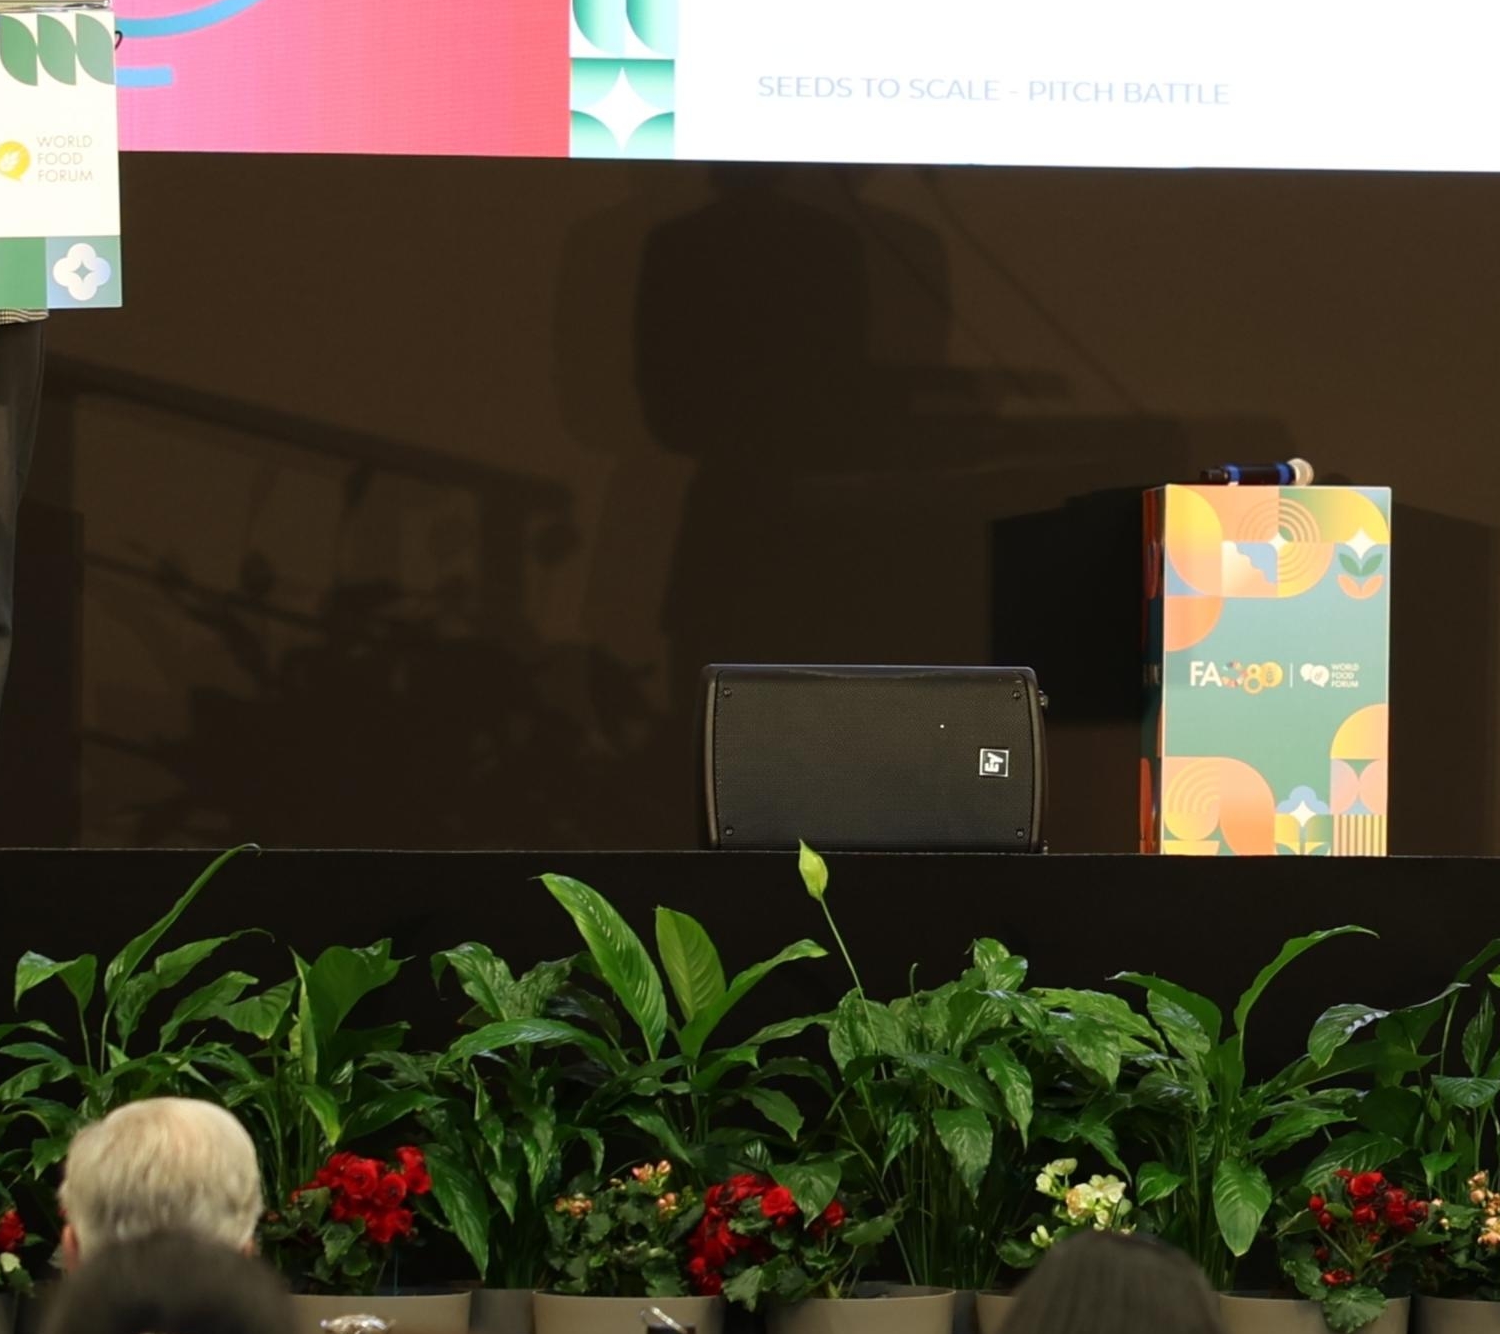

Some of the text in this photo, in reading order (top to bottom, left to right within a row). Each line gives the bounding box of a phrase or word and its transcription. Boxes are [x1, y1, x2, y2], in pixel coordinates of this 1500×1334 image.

[757, 74, 854, 99] SEEDS
[860, 76, 901, 100] TO
[908, 77, 1000, 102] SCALE
[1027, 79, 1114, 104] PITCH
[1123, 81, 1230, 106] BATTLE
[37, 135, 93, 148] WORLD
[37, 152, 84, 165] FOOD
[38, 170, 94, 183] FORUM
[1331, 663, 1360, 671] WORLD
[1331, 672, 1355, 680] FOOD
[1331, 680, 1360, 688] FORUM
